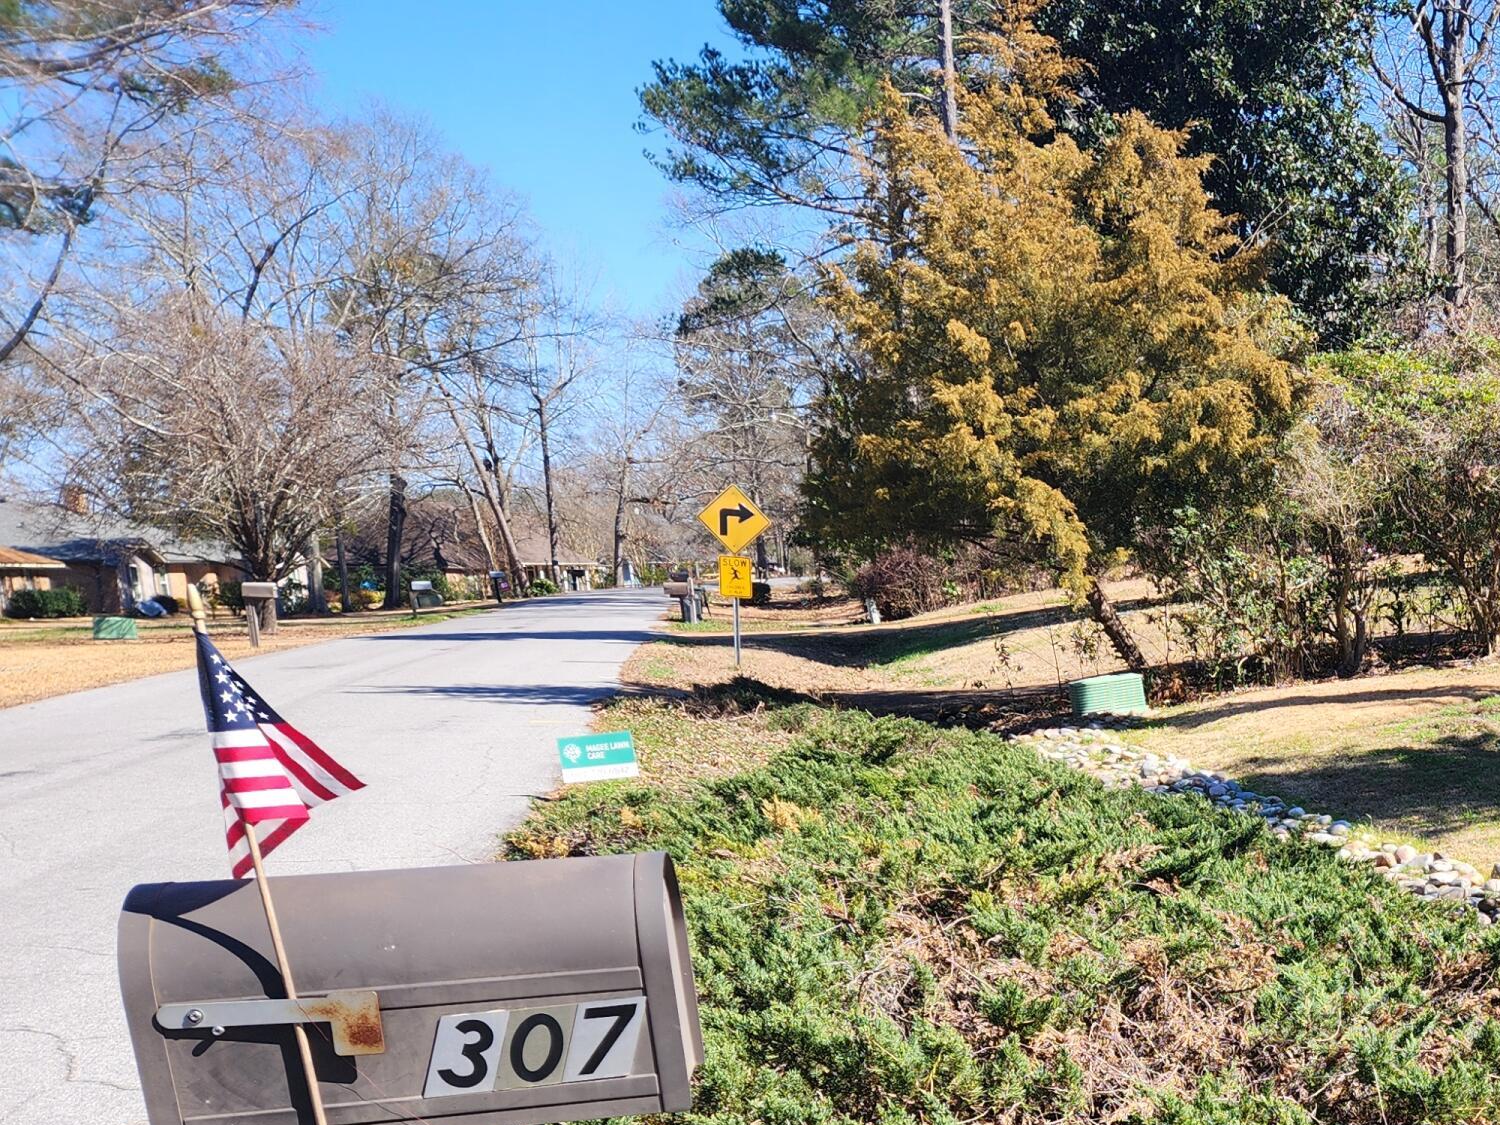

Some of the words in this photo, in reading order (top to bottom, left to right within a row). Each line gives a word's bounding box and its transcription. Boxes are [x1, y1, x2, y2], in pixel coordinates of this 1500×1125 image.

[722, 558, 747, 567] SLOW
[610, 741, 630, 750] LAWN
[587, 751, 605, 760] CARE
[437, 1003, 638, 1088] 307
